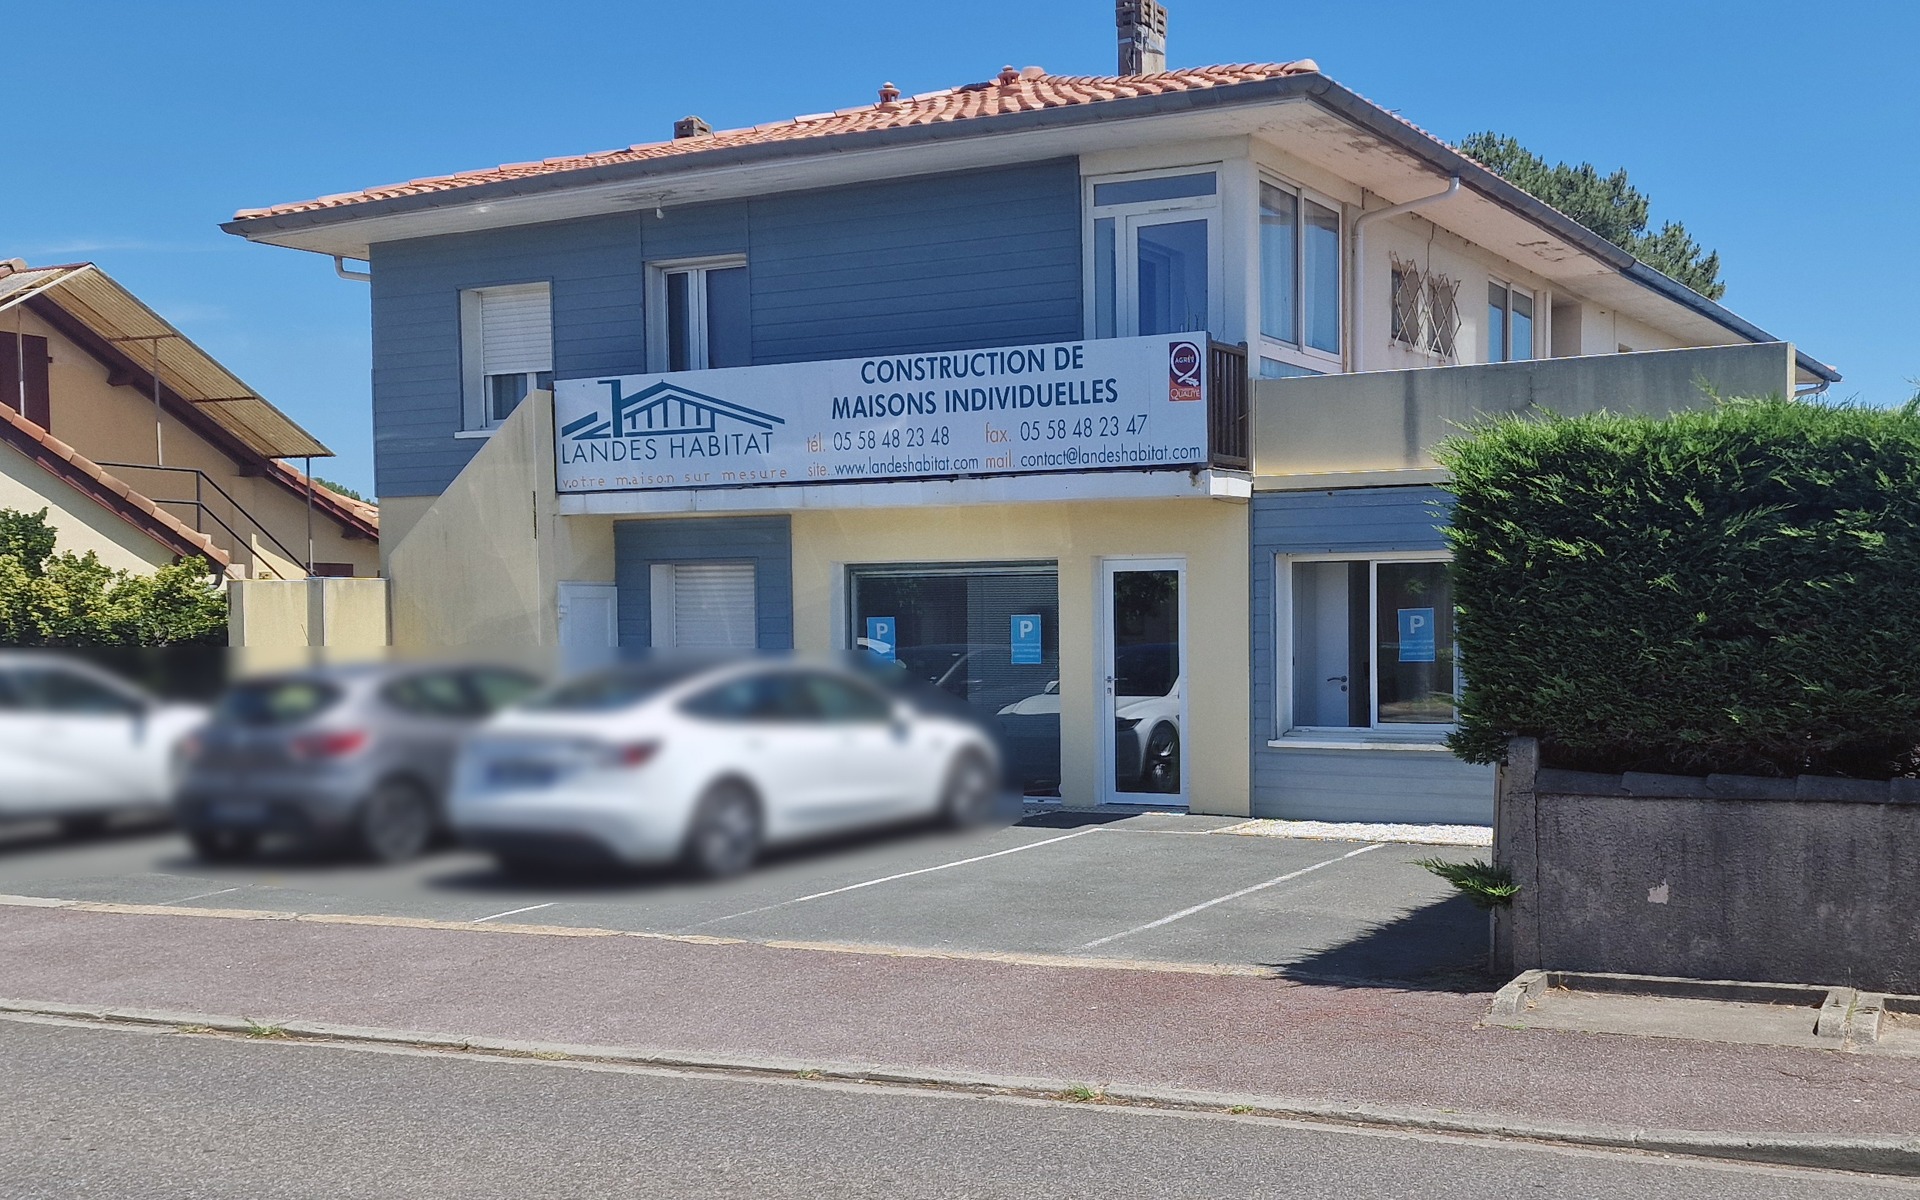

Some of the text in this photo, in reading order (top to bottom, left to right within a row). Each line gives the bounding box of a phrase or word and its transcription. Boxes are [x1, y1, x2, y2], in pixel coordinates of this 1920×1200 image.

[861, 345, 1084, 384] CONSTRUCTION DE
[832, 378, 1118, 420] MAISONS INDIVIDUELLES
[807, 425, 950, 453] tél. 05 58 48 23 48
[985, 414, 1148, 443] fax. 05 58 48 23 47
[561, 431, 774, 464] LANDES HABITAT
[985, 442, 1201, 469] mail. contact@landeshabitat.com
[562, 466, 788, 489] votre maison sur mesure
[834, 453, 979, 476] www.landeshabitat.com
[876, 623, 889, 640] P
[1019, 620, 1034, 639] P
[1410, 615, 1425, 634] P
